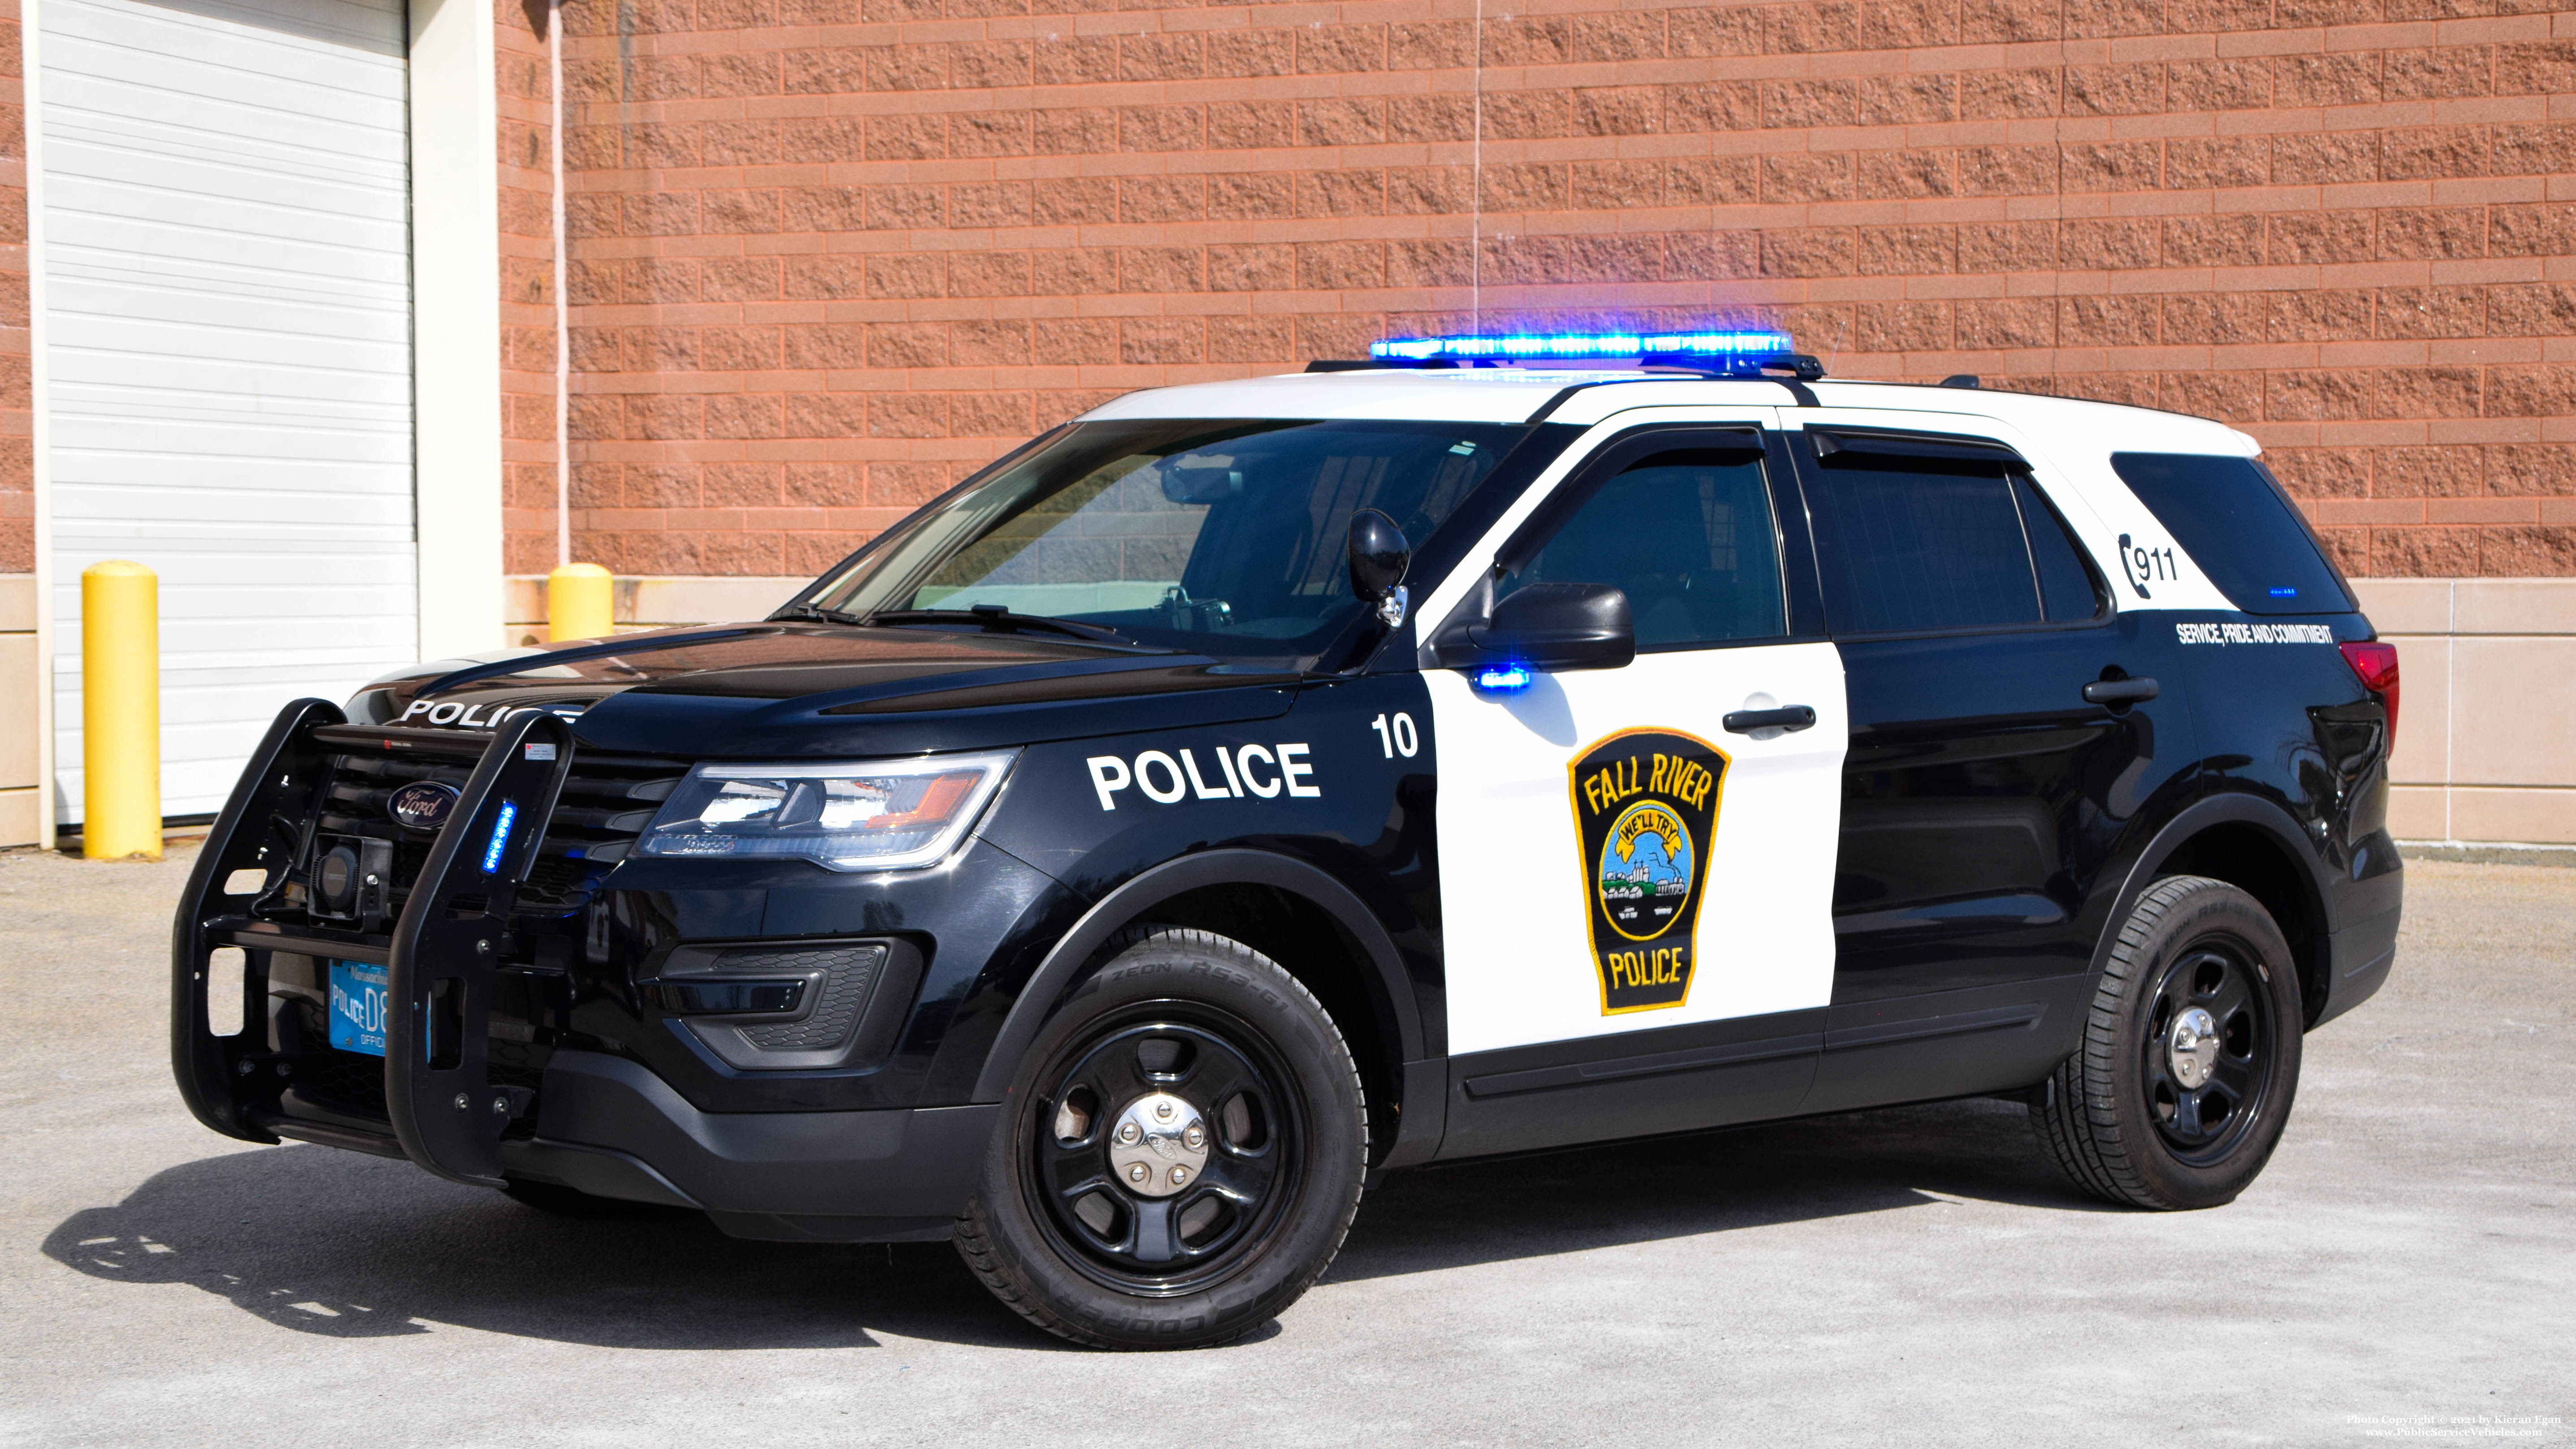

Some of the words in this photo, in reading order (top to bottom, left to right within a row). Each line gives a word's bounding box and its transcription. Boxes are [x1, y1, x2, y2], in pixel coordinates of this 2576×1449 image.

[2134, 547, 2177, 581] 911
[2176, 623, 2225, 647] SERVICE,
[2221, 623, 2253, 644] PRIDE
[2251, 624, 2274, 644] AND
[2271, 624, 2333, 644] COMMITMENT
[1372, 712, 1418, 758] 10
[1087, 743, 1321, 811] POLICE
[1584, 756, 1642, 815] FALL
[1649, 753, 1712, 811] RIVER
[397, 788, 442, 816] Ford
[1657, 814, 1677, 840] TRY
[1112, 962, 1172, 982] ZEON
[1189, 961, 1290, 1012] RS3-G1
[1609, 947, 1683, 990] POLICE
[333, 984, 364, 1029] POLICE
[1054, 1292, 1205, 1337] COOPER
